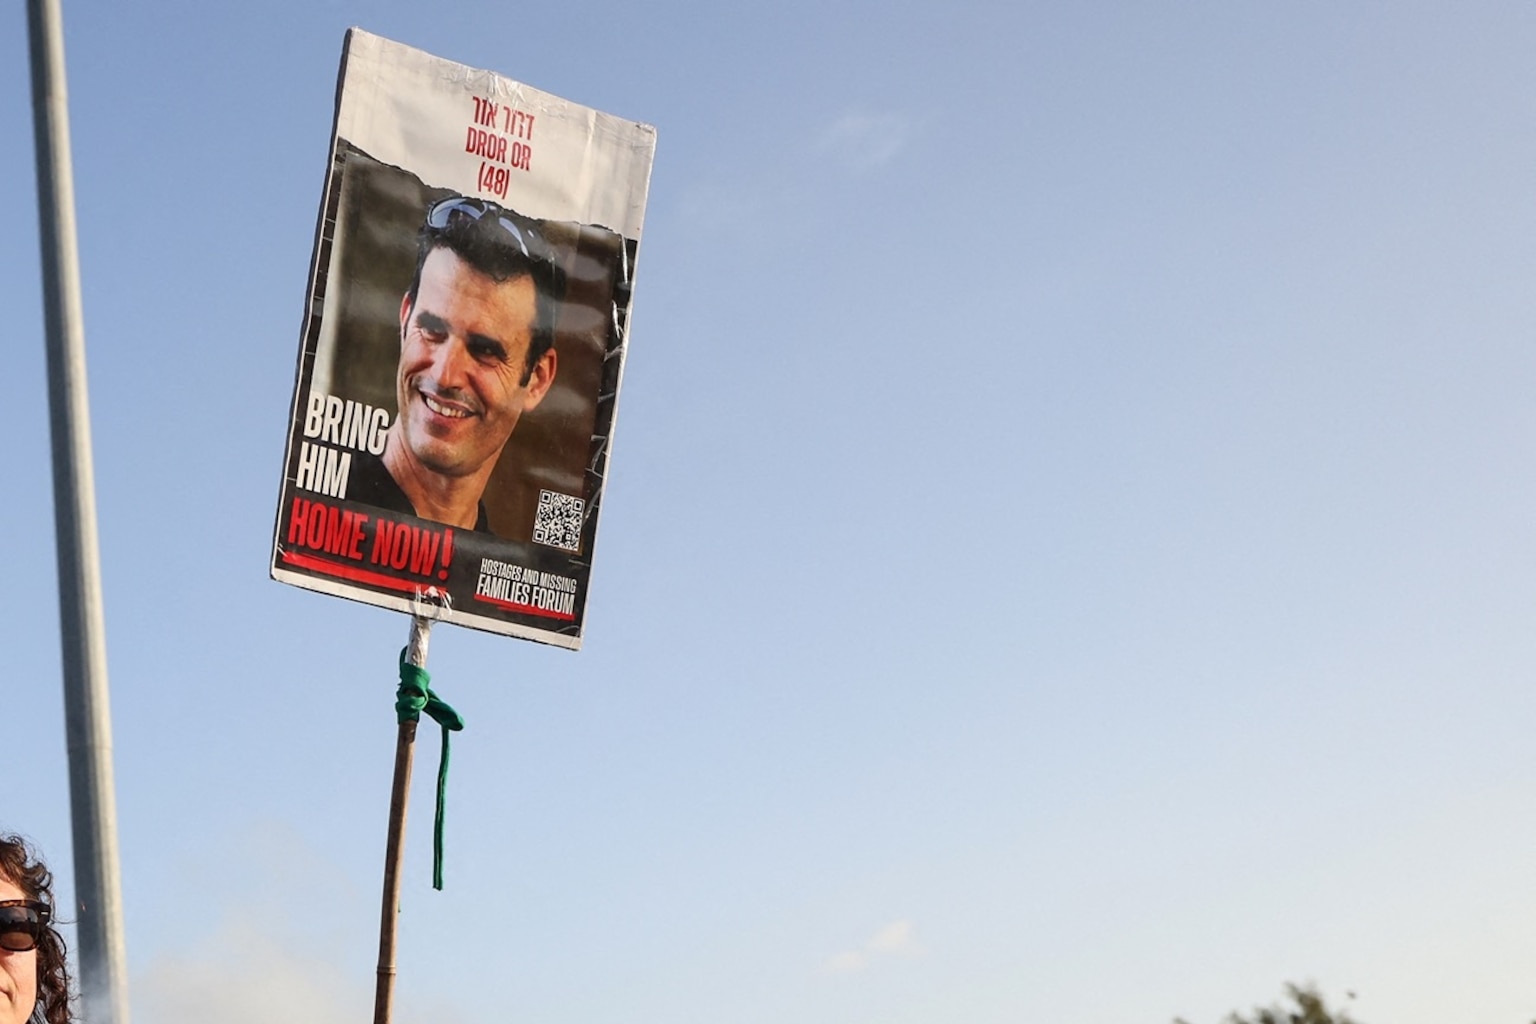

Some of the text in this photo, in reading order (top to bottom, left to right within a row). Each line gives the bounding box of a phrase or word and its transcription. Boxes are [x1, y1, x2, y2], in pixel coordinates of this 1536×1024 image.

[472, 96, 535, 140] דרור אור
[465, 126, 532, 171] DROR OR
[477, 161, 511, 199] (48)
[303, 391, 390, 455] BRING
[295, 441, 352, 500] HIM
[288, 497, 454, 581] HOME NOW!
[476, 574, 576, 615] FAMILIES FORUM
[480, 558, 577, 594] HOSTAGES AND MISSING
